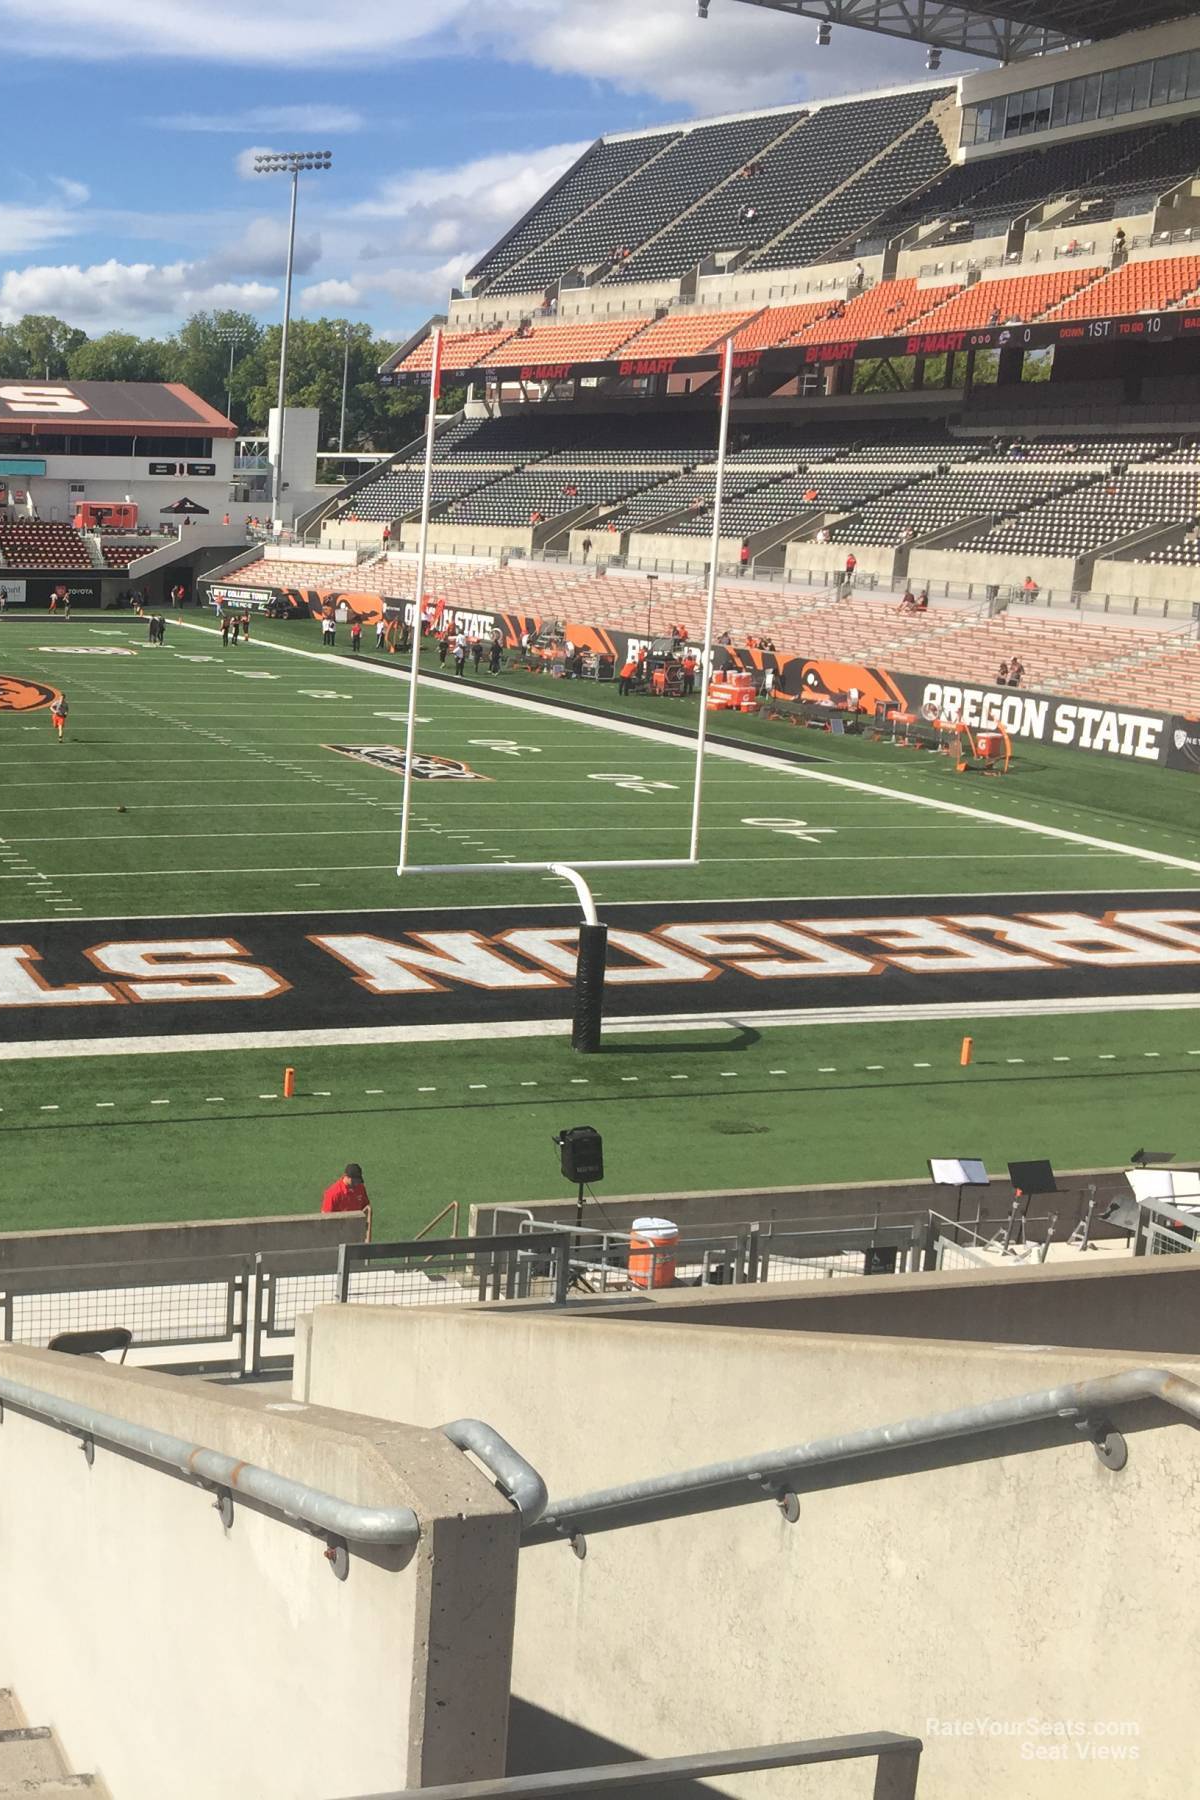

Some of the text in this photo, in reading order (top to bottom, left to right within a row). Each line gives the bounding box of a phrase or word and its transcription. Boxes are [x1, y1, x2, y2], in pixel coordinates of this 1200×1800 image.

[1087, 321, 1112, 337] 1ST
[1147, 318, 1161, 333] 10
[67, 588, 93, 596] TOYOTA
[922, 683, 1164, 760] OREGON STATE
[977, 738, 987, 750] G
